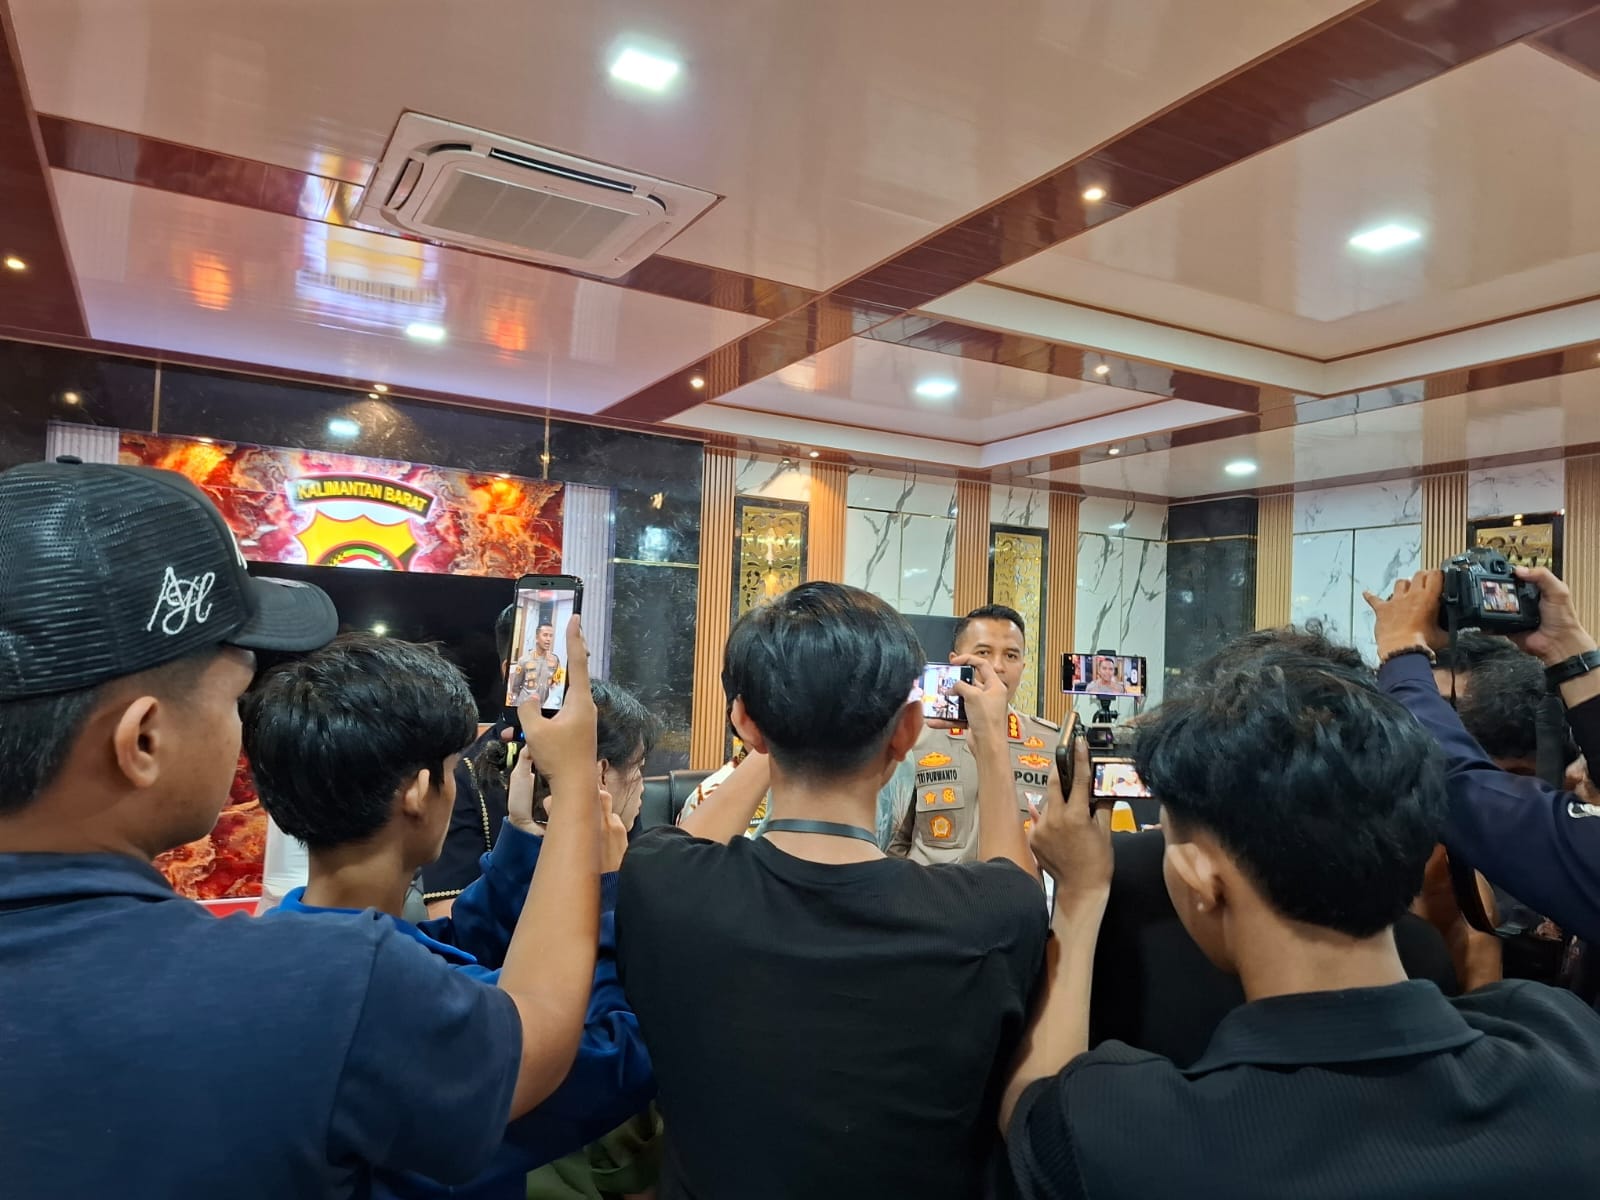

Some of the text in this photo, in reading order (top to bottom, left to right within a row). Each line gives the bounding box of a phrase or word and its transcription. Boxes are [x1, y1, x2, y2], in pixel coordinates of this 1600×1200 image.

[297, 480, 428, 512] KALIMANTAN BARAT
[926, 769, 958, 783] PURWANTO
